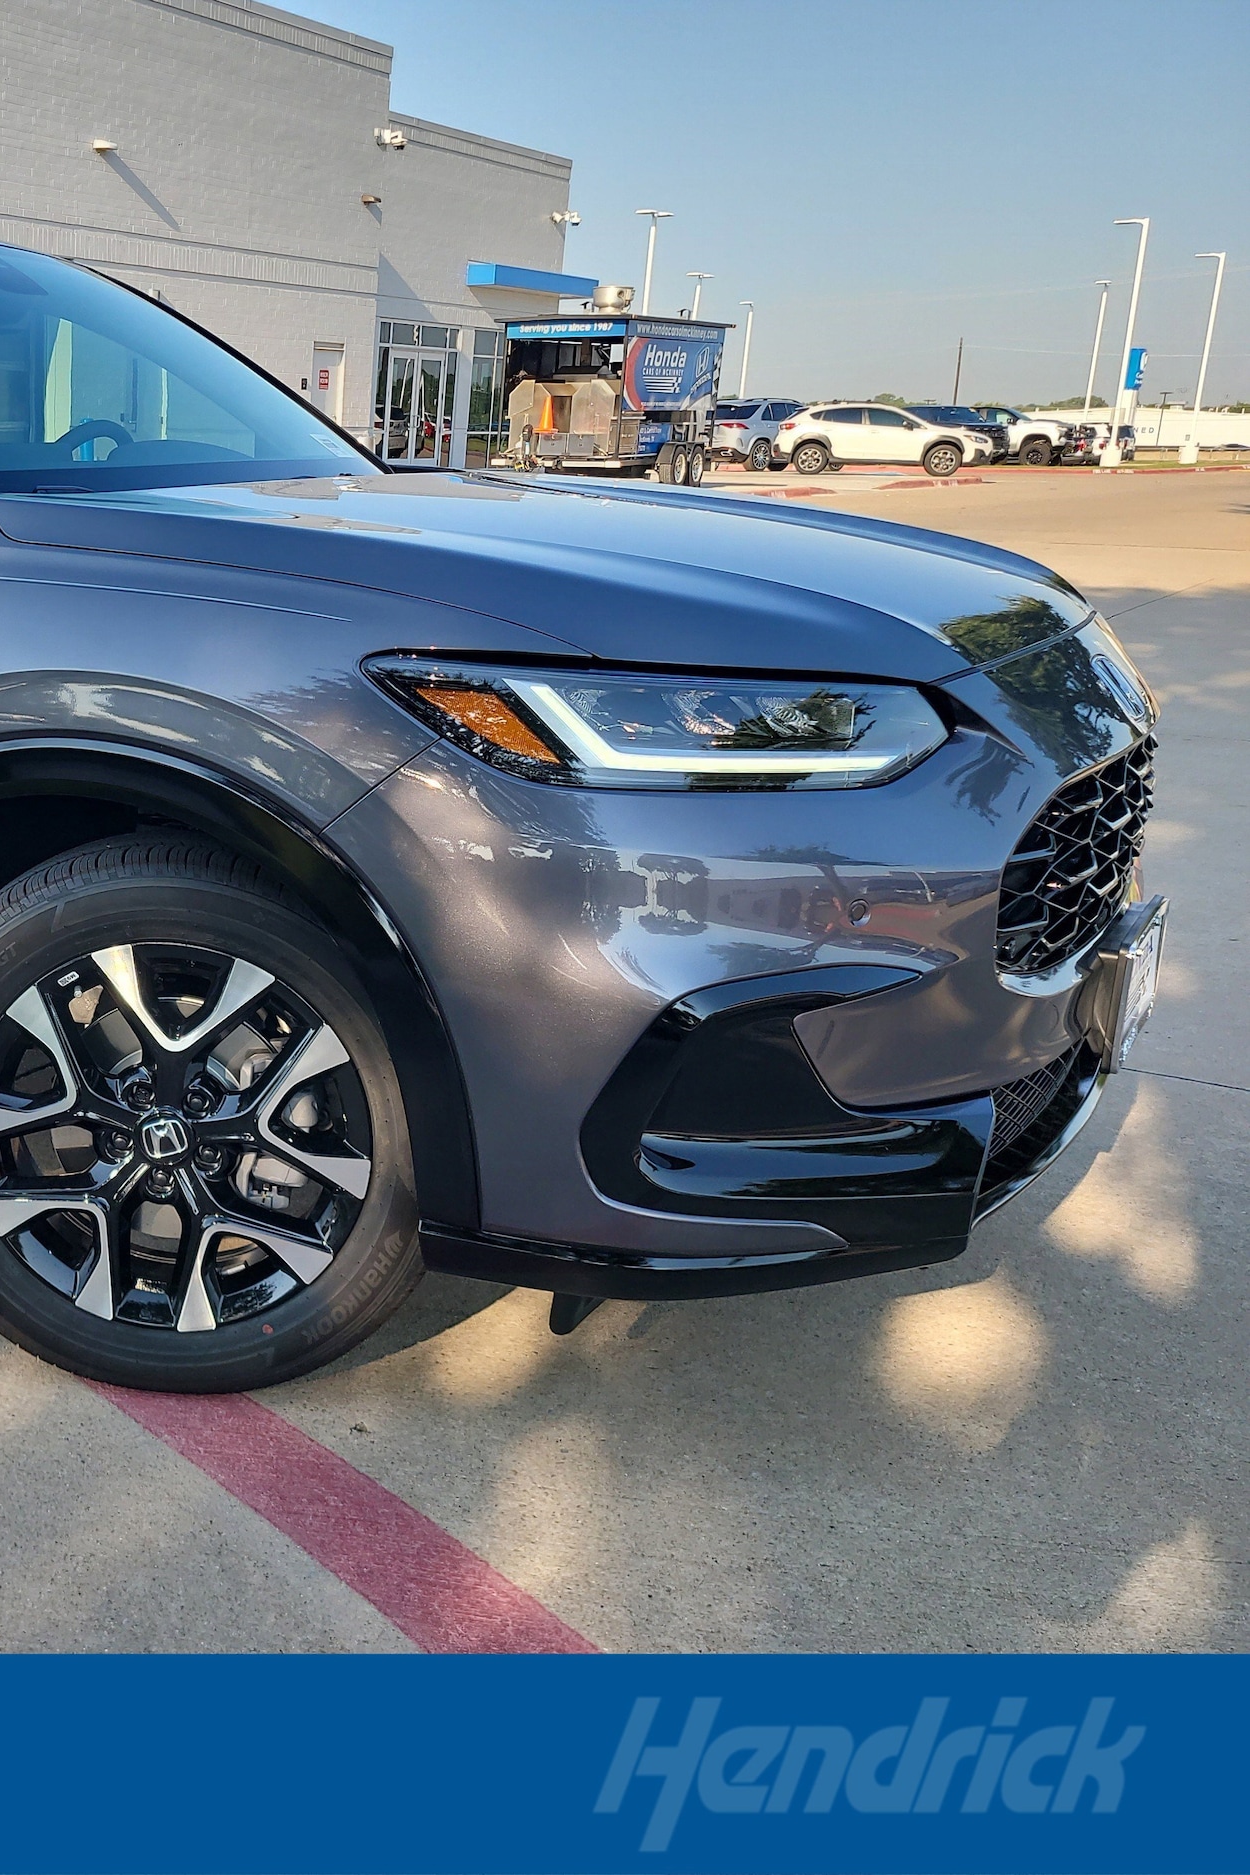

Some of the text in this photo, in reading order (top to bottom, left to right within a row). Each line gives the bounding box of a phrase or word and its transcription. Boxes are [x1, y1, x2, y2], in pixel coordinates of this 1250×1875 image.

[519, 324, 548, 334] Serving
[551, 324, 568, 334] you
[568, 323, 591, 332] since
[644, 343, 687, 368] Honda
[642, 367, 654, 375] CARS
